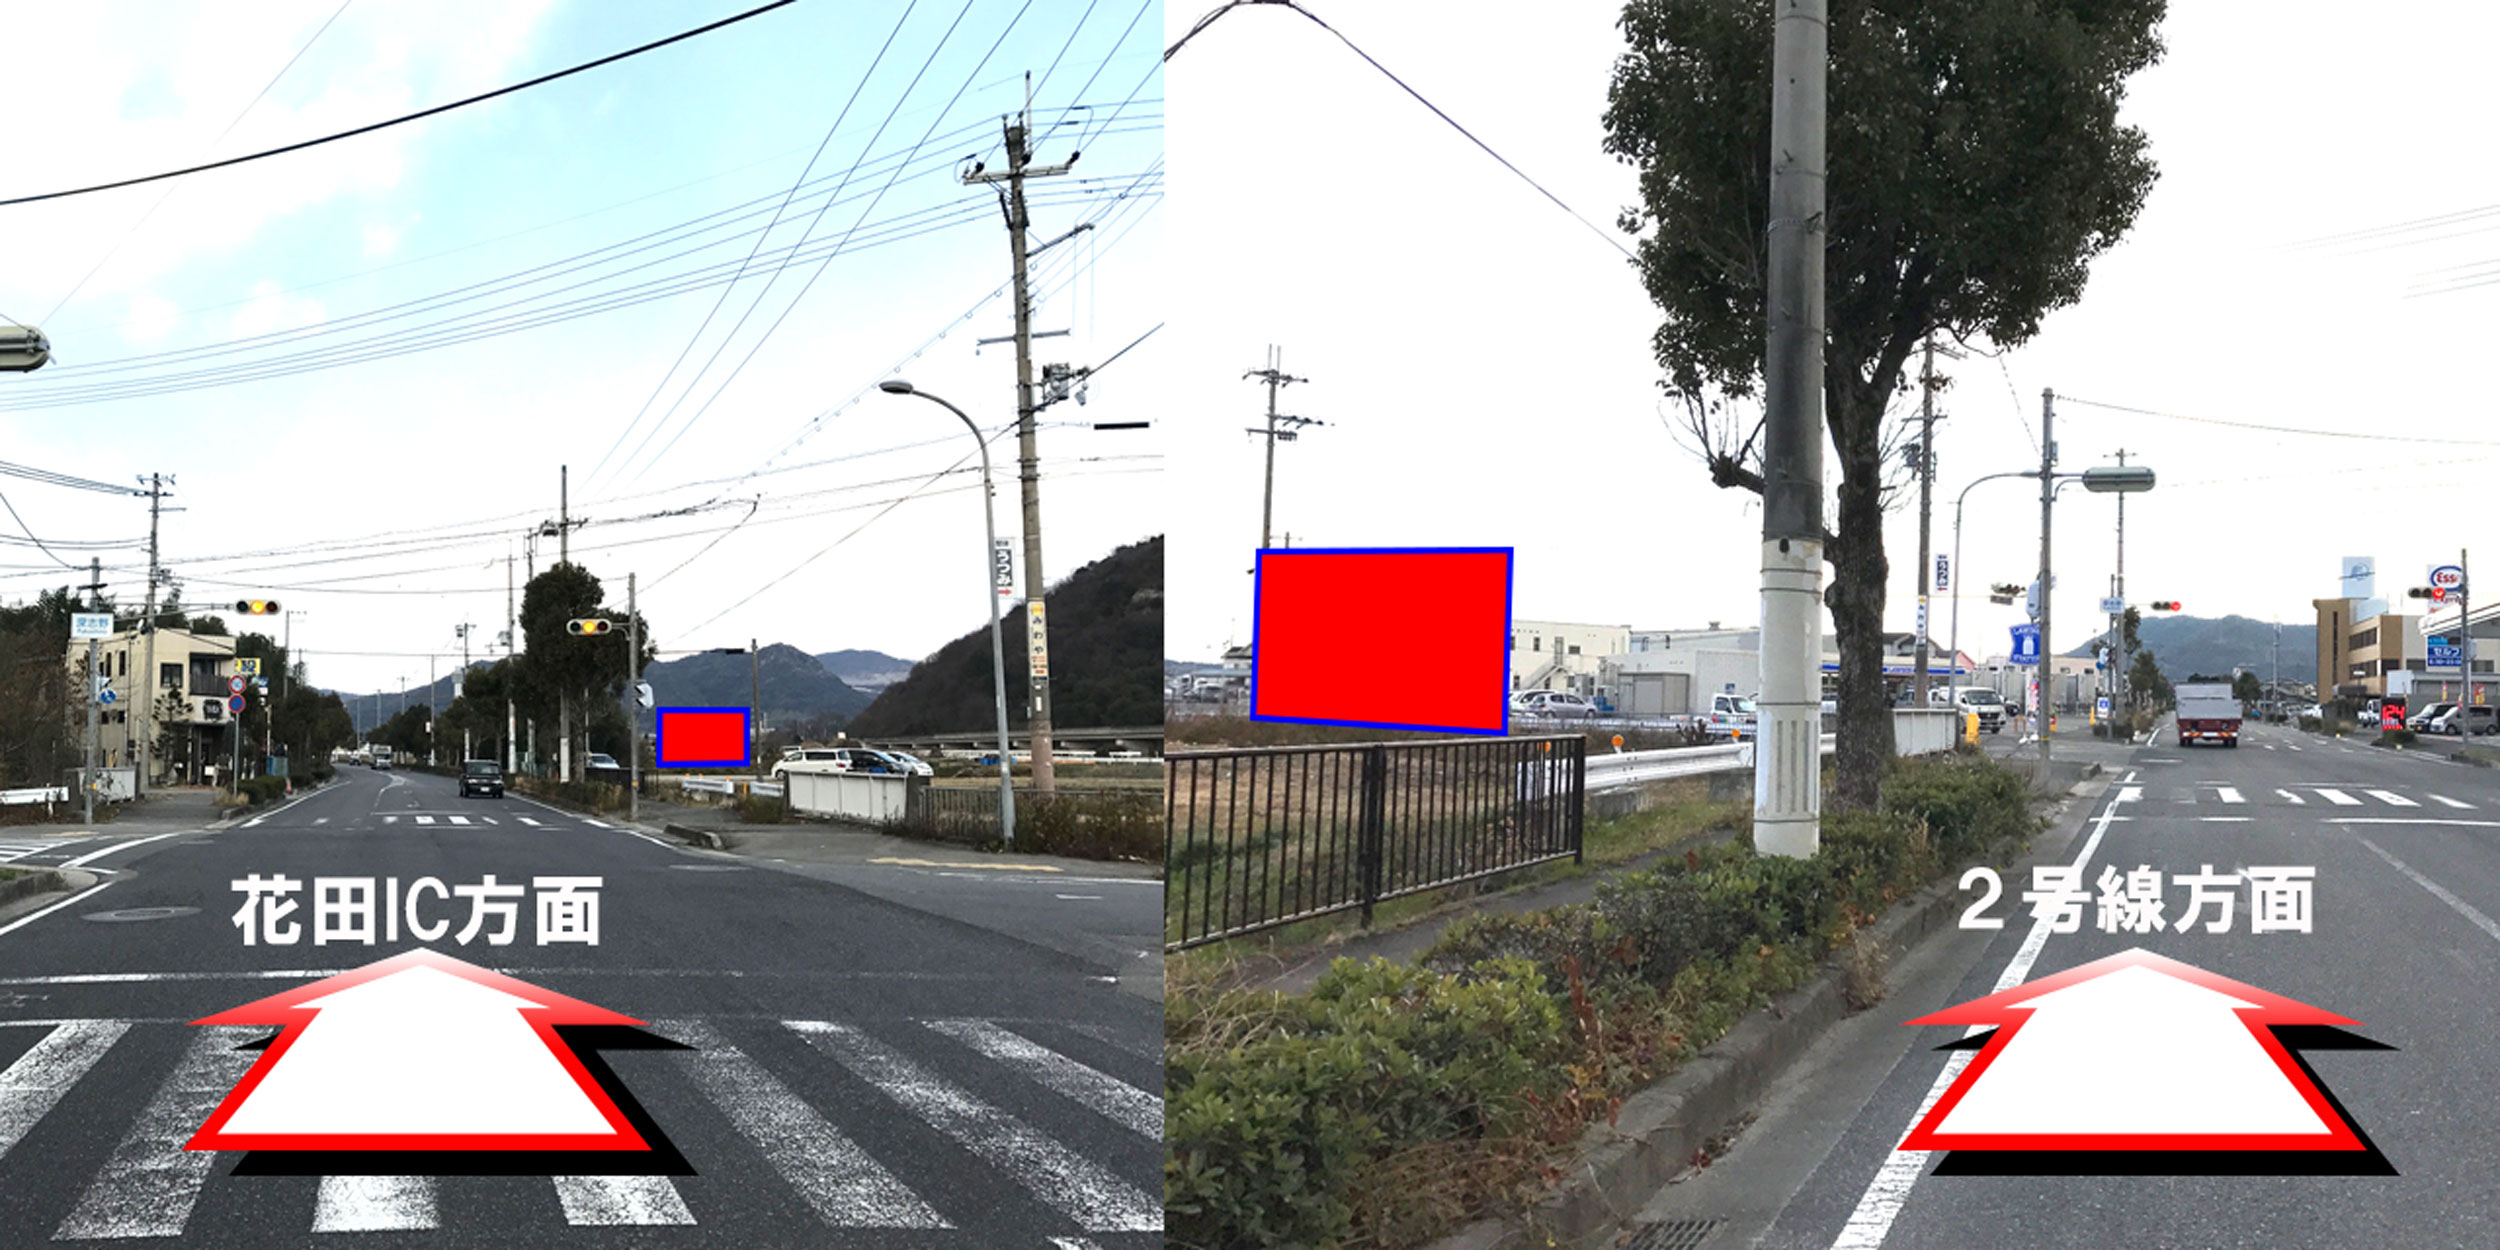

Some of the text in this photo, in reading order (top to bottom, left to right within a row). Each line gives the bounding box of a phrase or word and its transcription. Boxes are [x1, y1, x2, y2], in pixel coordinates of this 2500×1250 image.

[997, 550, 1011, 585] うつみ
[2436, 572, 2459, 584] Ess
[1032, 617, 1044, 654] みわや
[2434, 647, 2460, 656] セルフ
